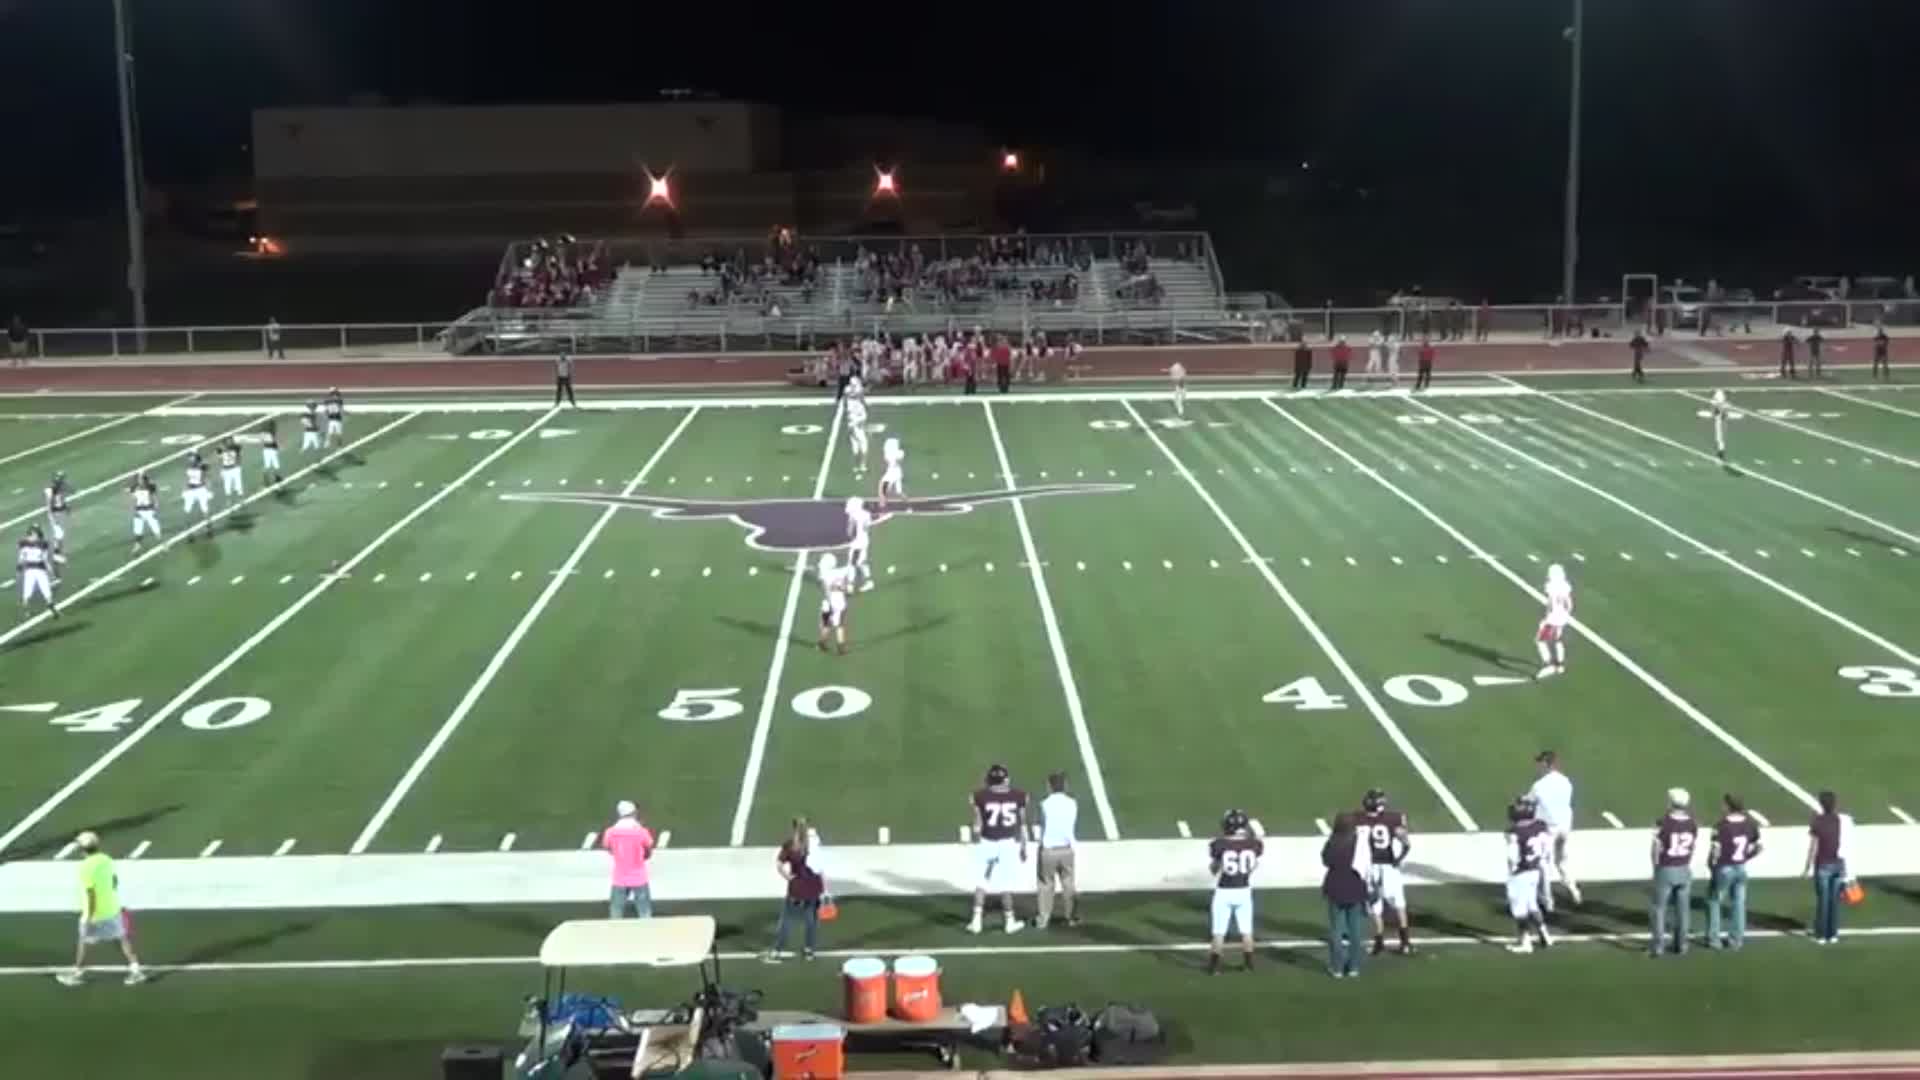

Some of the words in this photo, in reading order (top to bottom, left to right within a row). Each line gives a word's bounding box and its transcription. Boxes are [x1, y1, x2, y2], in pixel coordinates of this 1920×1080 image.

[657, 684, 873, 721] 50
[1262, 673, 1469, 711] 40
[49, 696, 272, 733] 40
[984, 801, 1018, 827] 75
[1666, 831, 1694, 857] 12
[1731, 834, 1748, 861] 7
[1222, 849, 1257, 876] 60
